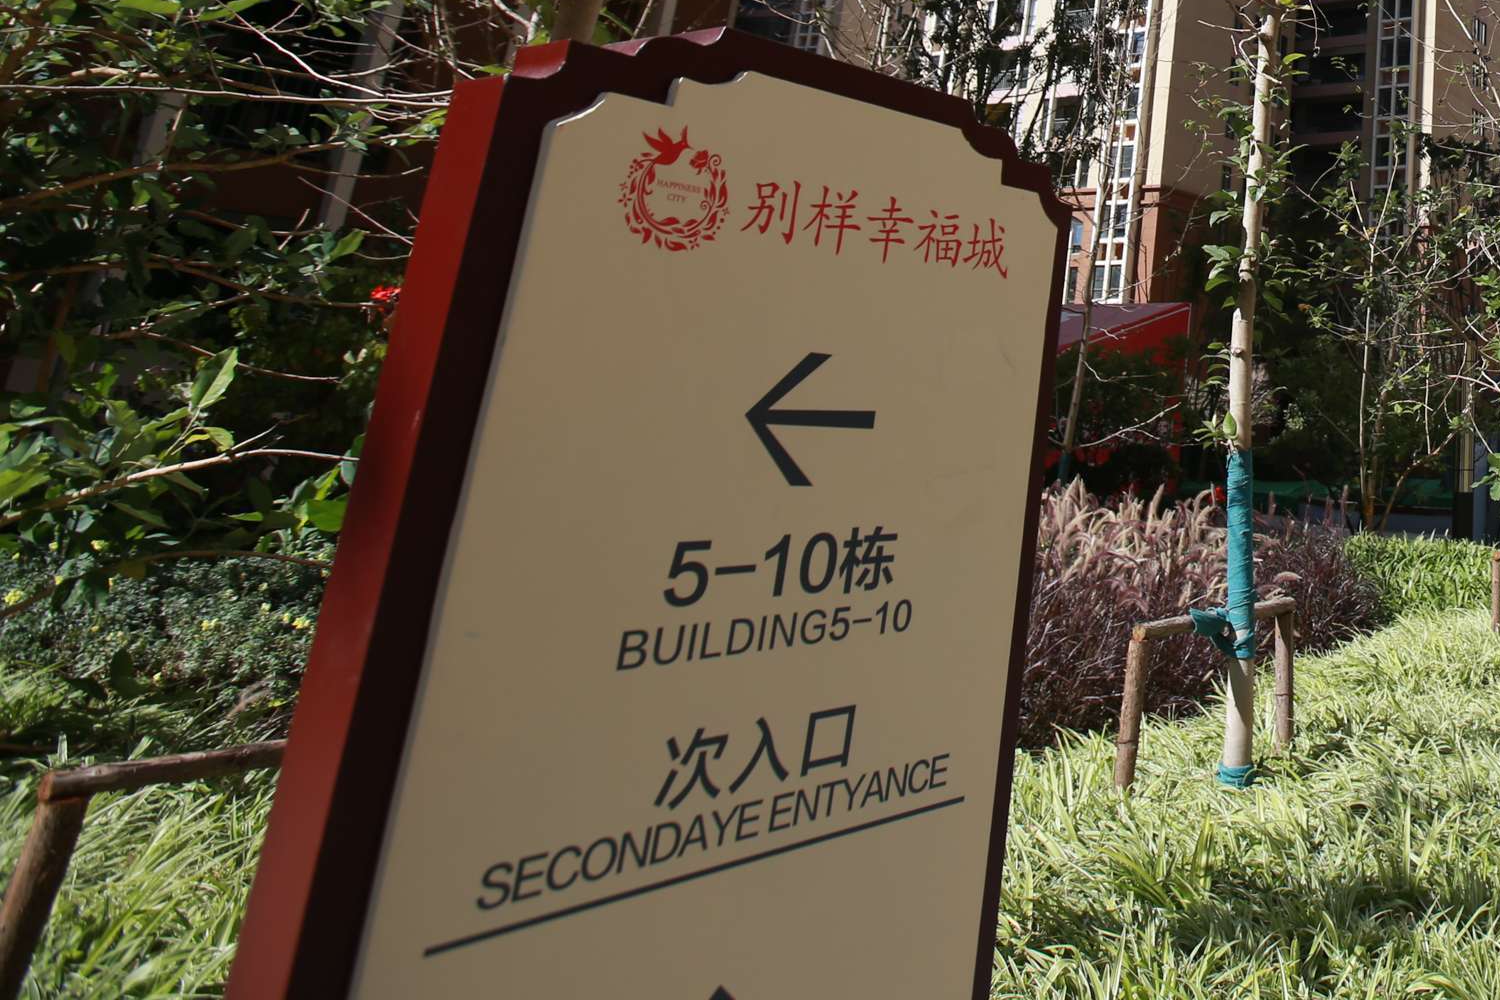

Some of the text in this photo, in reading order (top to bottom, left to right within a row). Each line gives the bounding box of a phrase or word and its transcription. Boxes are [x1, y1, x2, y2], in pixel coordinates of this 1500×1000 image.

[667, 193, 686, 204] CITY
[740, 180, 1008, 279] 别样幸福城
[663, 526, 898, 608] 5-10栋
[616, 599, 912, 671] BUILDING5-10
[653, 704, 857, 810] 次入口
[476, 753, 950, 911] SECONDAYE ENTYANCE
